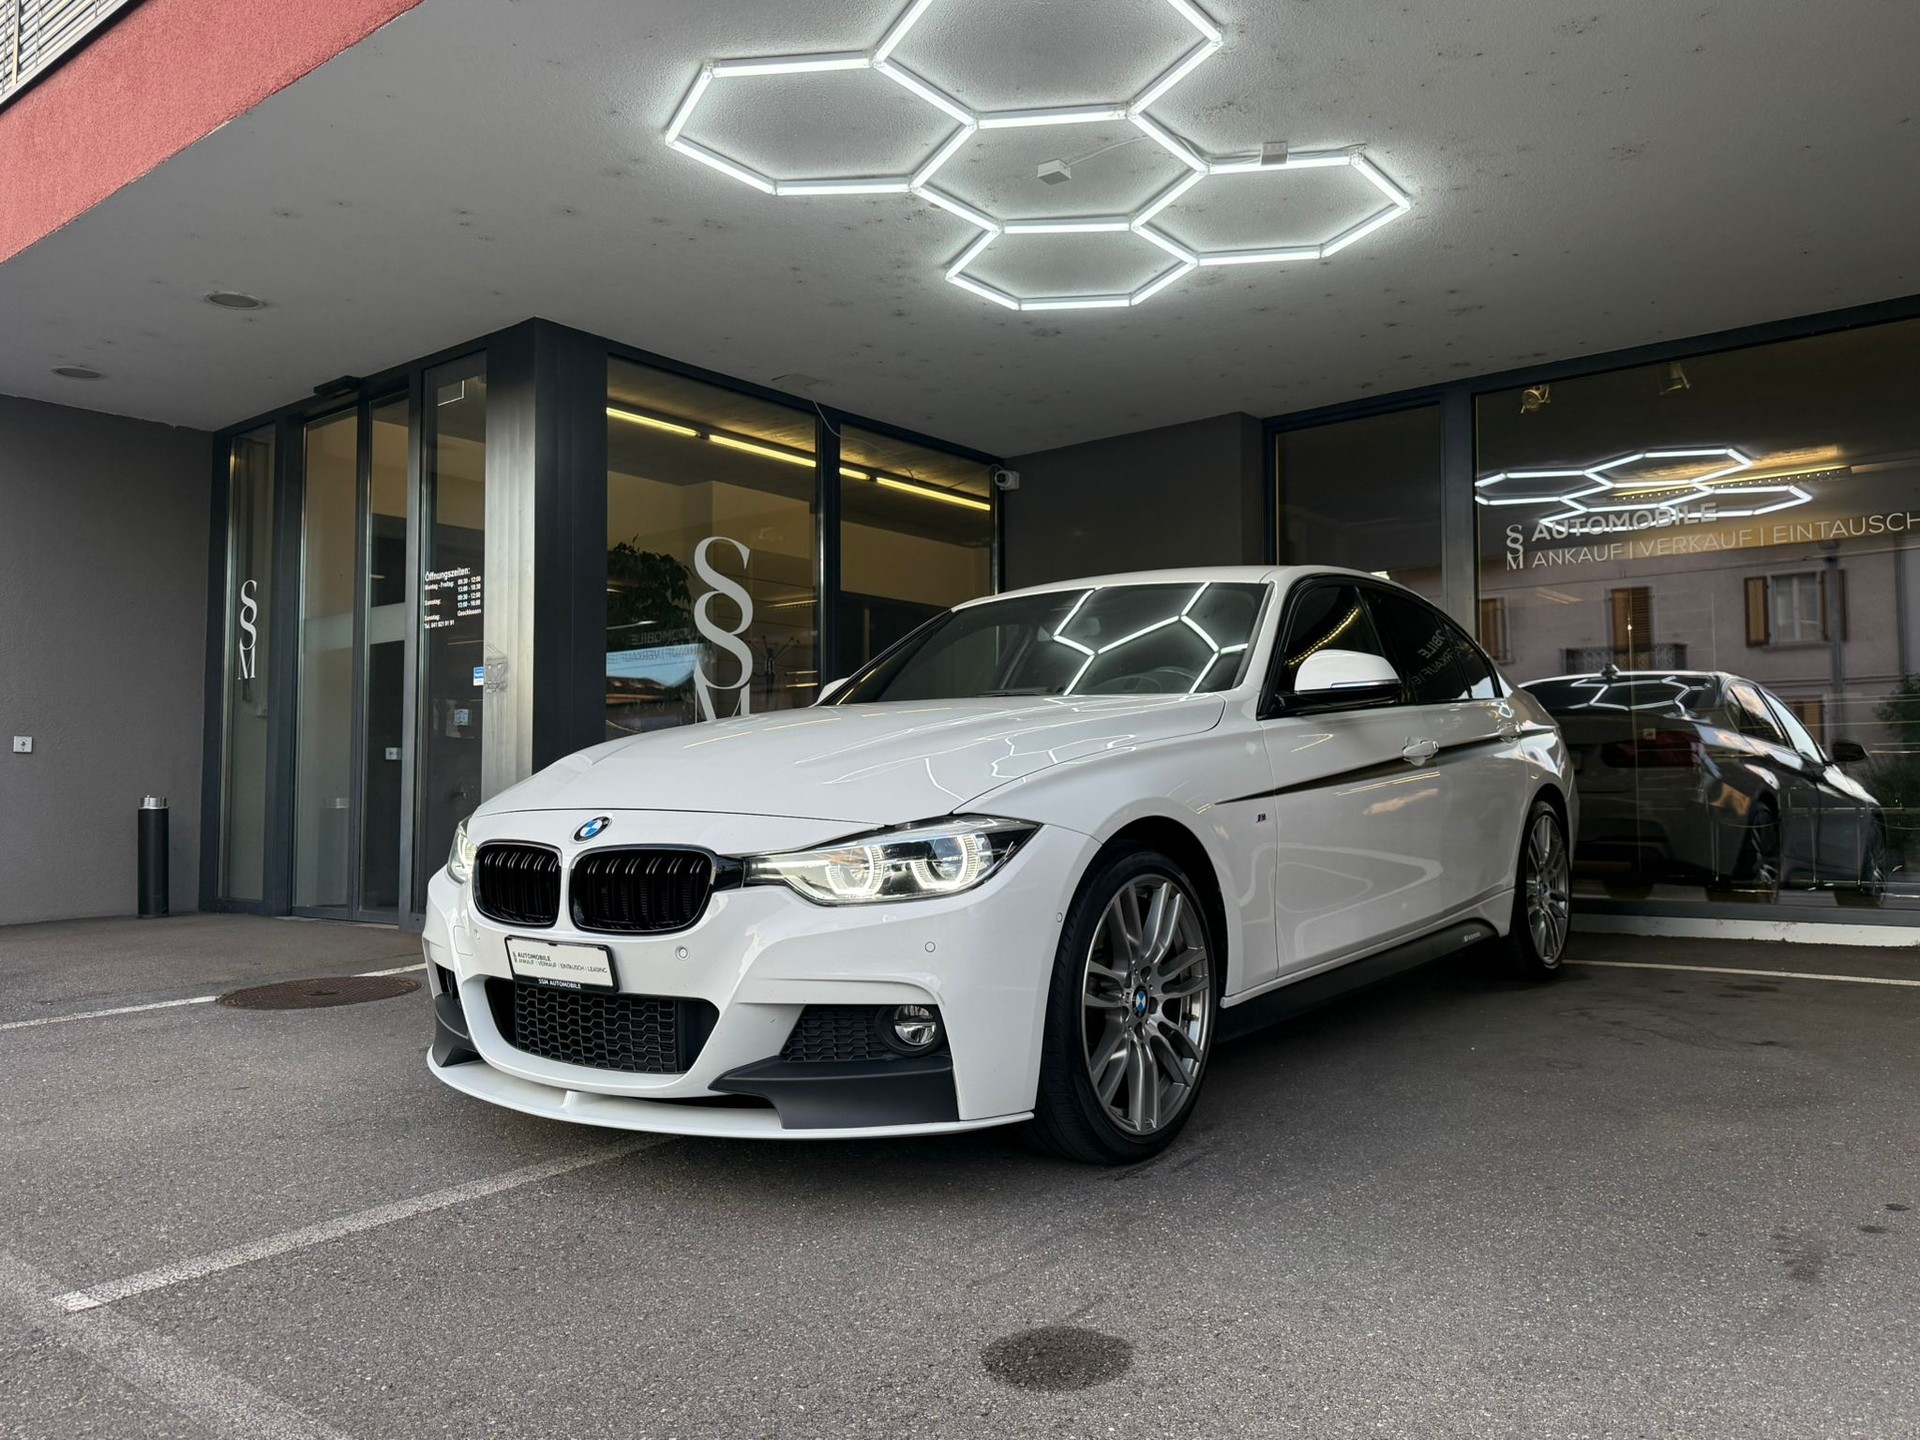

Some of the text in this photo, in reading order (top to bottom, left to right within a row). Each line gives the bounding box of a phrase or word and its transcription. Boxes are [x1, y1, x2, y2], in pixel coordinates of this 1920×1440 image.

[1531, 502, 1717, 542] AUTOMOBILE
[1532, 543, 1622, 568] ANKAUF
[1640, 529, 1752, 557] VERKAUF
[425, 567, 470, 581] Öffnungszeiten:
[518, 952, 551, 962] AUTOMOBILE
[550, 980, 581, 990] AUTOMOBILE
